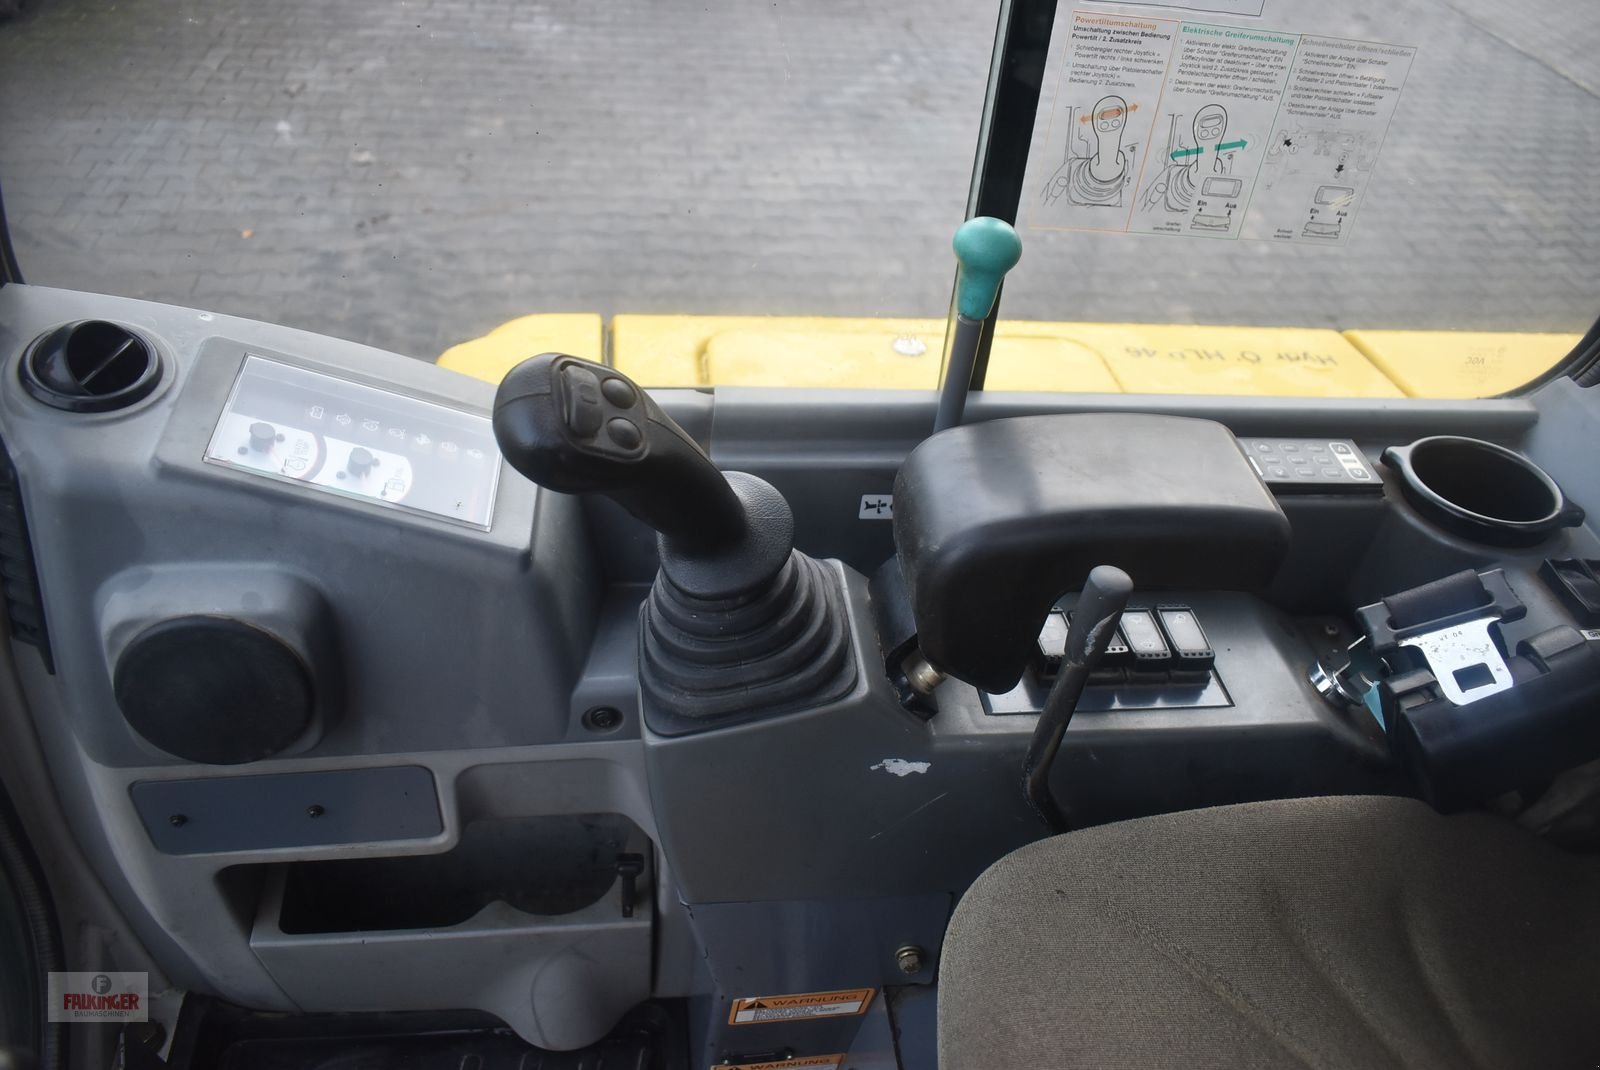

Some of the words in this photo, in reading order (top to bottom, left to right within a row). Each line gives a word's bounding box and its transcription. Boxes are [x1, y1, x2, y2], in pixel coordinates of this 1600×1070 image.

[1075, 16, 1157, 31] Powertiltumschaltung
[1074, 25, 1111, 35] Umschaltung
[1112, 28, 1139, 37] zwischen
[1140, 30, 1170, 40] Bedienung
[1182, 26, 1222, 36] Elektrische
[1225, 31, 1294, 46] Greiferumschaltung
[1109, 36, 1142, 45] Zusatzkreis
[1302, 38, 1356, 51] Schnellwechsler
[1076, 44, 1112, 54] Schieberegler
[1238, 45, 1288, 56] Greiferumschaltung
[1072, 62, 1107, 72] Umschaltung
[1220, 66, 1249, 74] Zusatzkreis
[1069, 77, 1098, 86] Bedienung
[1233, 84, 1281, 96] Greiferumschaltung
[773, 994, 857, 1006] WARNUNG
[750, 1058, 831, 1070] WARNUNG
